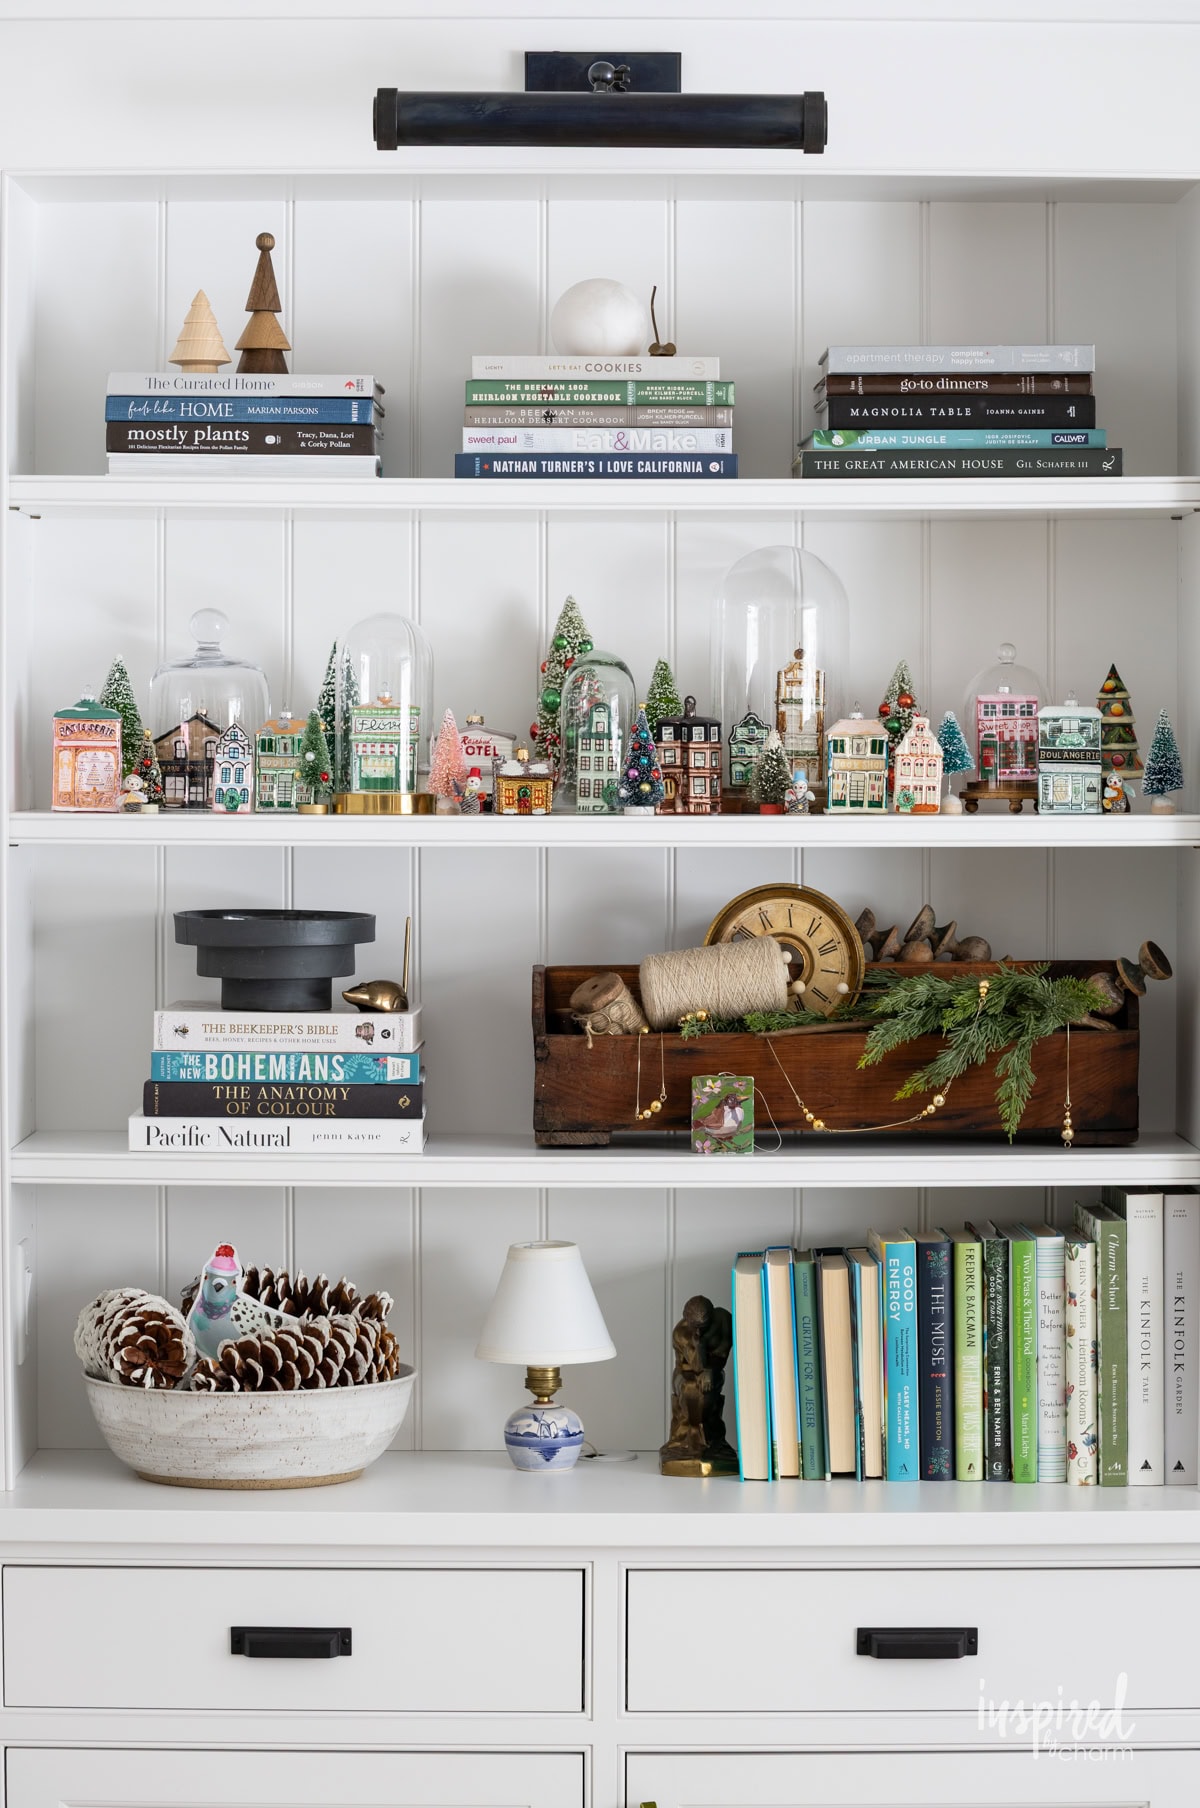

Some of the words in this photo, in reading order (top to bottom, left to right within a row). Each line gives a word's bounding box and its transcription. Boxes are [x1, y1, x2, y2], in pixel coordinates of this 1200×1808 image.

[846, 353, 901, 364] apartment
[904, 352, 944, 365] therapy
[951, 350, 984, 359] complete
[951, 358, 973, 366] happy
[585, 363, 642, 372] COOKIES
[145, 377, 170, 390] The
[174, 378, 231, 390] Curated
[235, 378, 275, 390] Home
[900, 378, 933, 392] go-to
[936, 378, 988, 390] dinners
[128, 400, 151, 419] feels
[153, 400, 175, 413] like
[180, 402, 234, 417] HOME
[247, 406, 281, 414] MARIAN
[850, 408, 923, 416] MAGNOLIA
[930, 408, 971, 416] TABLE
[128, 425, 188, 444] mostly
[194, 425, 250, 445] plants
[468, 436, 495, 444] sweet
[497, 436, 517, 445] paul
[858, 436, 896, 444] URBAN
[902, 436, 946, 444] JUNGLE
[1054, 435, 1086, 443] CALLWEY
[493, 460, 537, 472] NATHAN
[541, 460, 595, 472] TURNER'S
[599, 461, 602, 472] I
[607, 461, 633, 472] LOVE
[638, 461, 703, 472] CALIFORNIA
[814, 461, 840, 470] THE
[845, 460, 886, 470] GREAT
[890, 460, 956, 469] AMERICAN
[962, 460, 1003, 469] HOUSE
[460, 745, 499, 757] OTEL
[202, 1024, 226, 1034] THE
[229, 1024, 303, 1035] BEEKEEPER'S
[307, 1025, 338, 1035] BIBLE
[183, 1055, 201, 1066] THE
[205, 1054, 344, 1081] BOHEMIANS
[180, 1068, 201, 1079] NEW
[213, 1086, 250, 1099] THE
[257, 1086, 351, 1100] ANATOMY
[226, 1102, 250, 1114] OF
[257, 1102, 336, 1115] COLOUR
[146, 1125, 210, 1146] Pacific
[217, 1126, 290, 1147] Natural
[312, 1133, 342, 1142] jenni
[348, 1133, 381, 1141] kayne
[1108, 1234, 1119, 1271] Charm
[965, 1248, 975, 1292] FREDRIK
[1023, 1253, 1031, 1274] Two
[889, 1258, 900, 1321] ENERGY
[903, 1266, 913, 1312] GOOD
[1023, 1277, 1031, 1297] Peas
[1041, 1291, 1061, 1300] Better
[1109, 1274, 1120, 1310] School
[931, 1284, 944, 1315] THE
[1043, 1305, 1059, 1314] Than
[966, 1296, 976, 1348] BACKMAN
[990, 1294, 1002, 1348] SOMETHING
[1024, 1310, 1032, 1337] Their
[1041, 1320, 1063, 1332] Before
[802, 1315, 813, 1357] CURTAIN
[1140, 1300, 1151, 1370] KINFOLK
[1174, 1296, 1185, 1372] KINFOLK
[931, 1323, 944, 1366] MUSE
[1024, 1340, 1032, 1355] Pod
[804, 1362, 814, 1380] FOR
[1079, 1338, 1088, 1388] Heirloom
[962, 1356, 980, 1408] BRITT-MARIE
[806, 1398, 815, 1428] JESTER
[1079, 1390, 1088, 1425] Rooms
[962, 1412, 980, 1430] WAS
[904, 1438, 910, 1450] MD
[963, 1434, 980, 1453] HERE
[1020, 1436, 1030, 1458] Lichty
